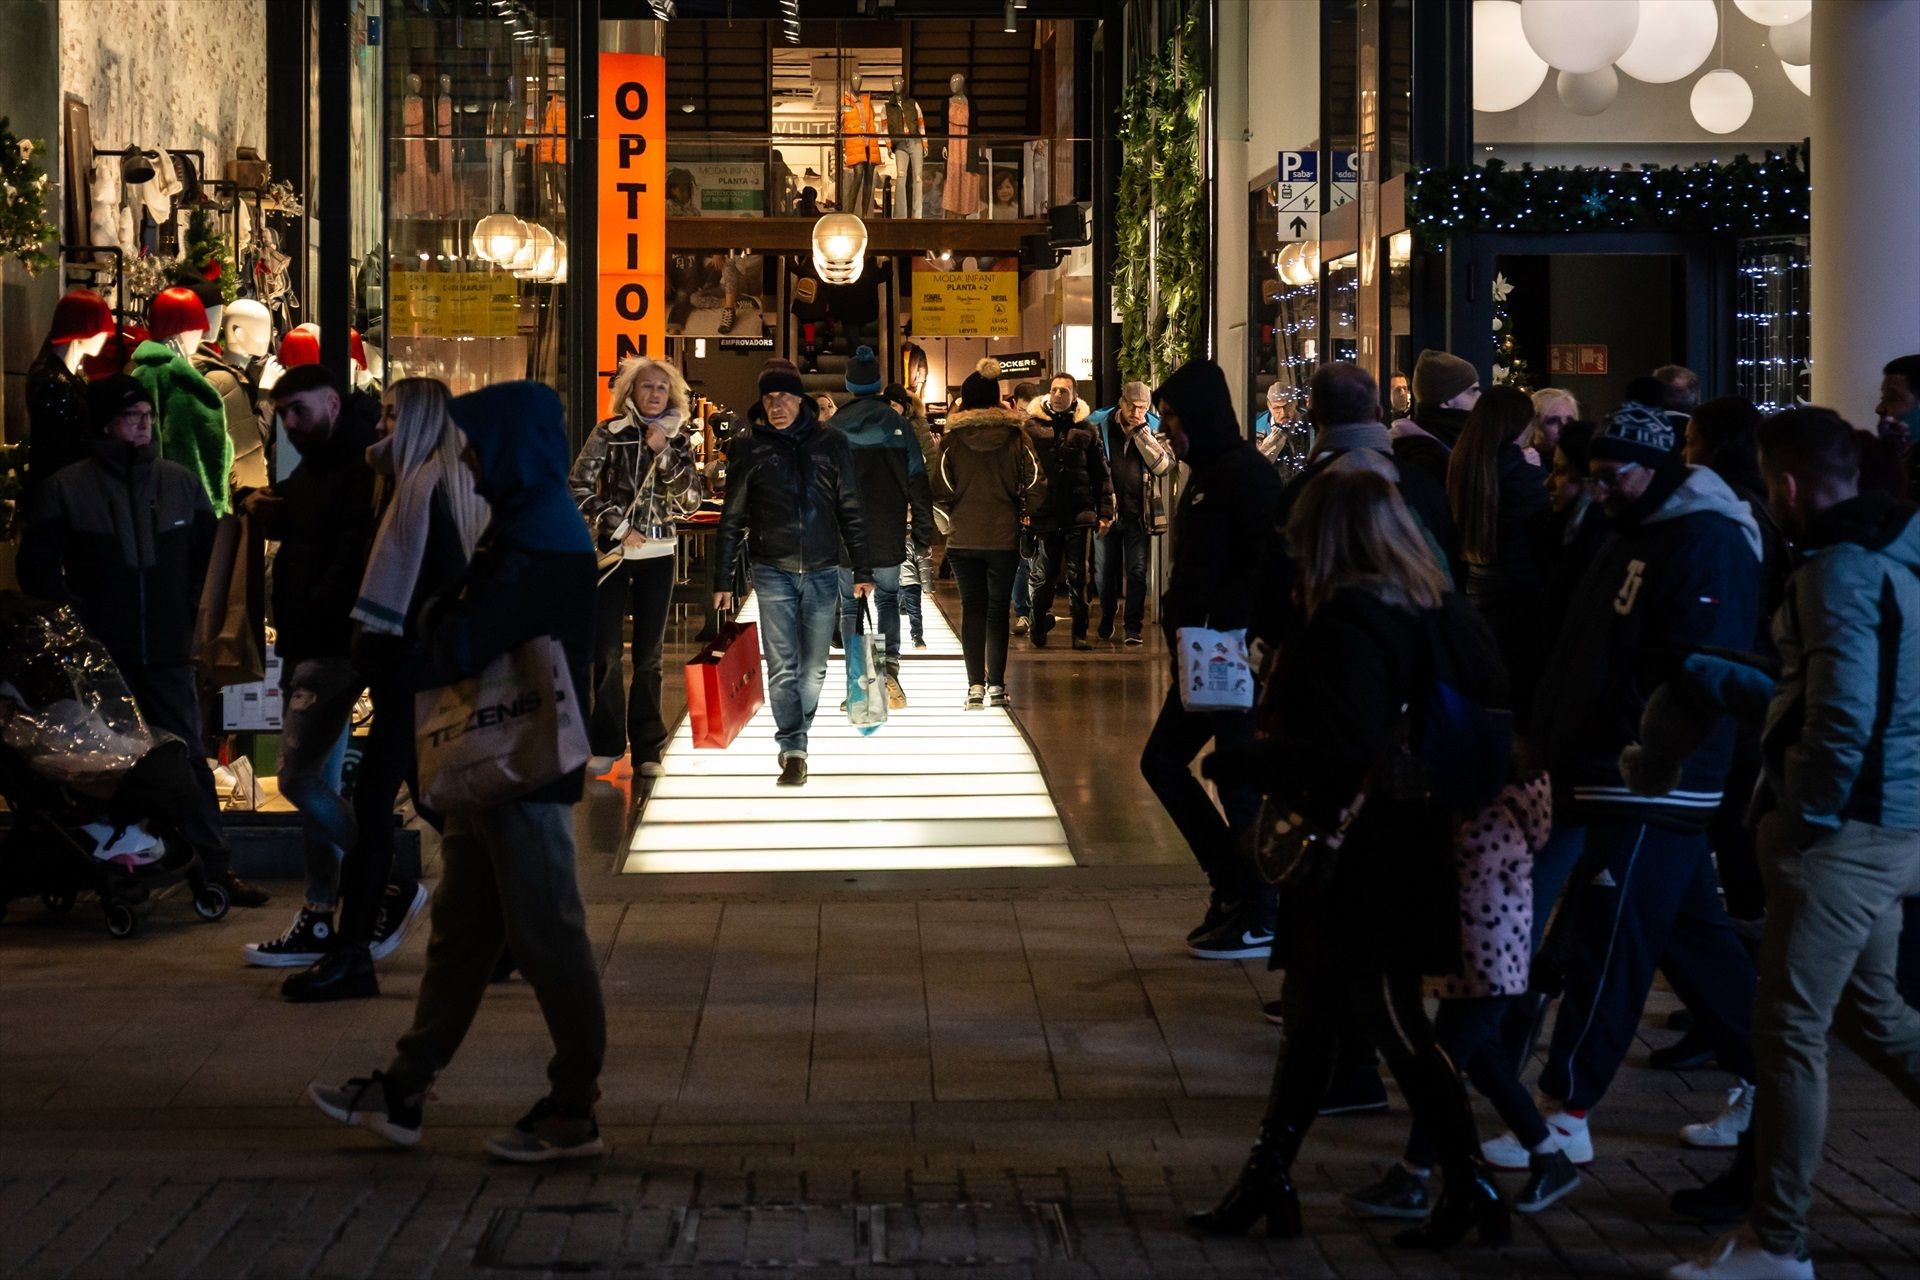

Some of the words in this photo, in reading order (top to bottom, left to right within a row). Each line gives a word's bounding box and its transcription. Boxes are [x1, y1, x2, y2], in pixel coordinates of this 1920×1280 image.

[1283, 152, 1302, 181] P
[1293, 170, 1312, 178] saba
[615, 81, 649, 369] OPTION
[933, 274, 961, 282] MODA
[965, 274, 995, 282] INFANT
[999, 359, 1037, 369] OCKERS
